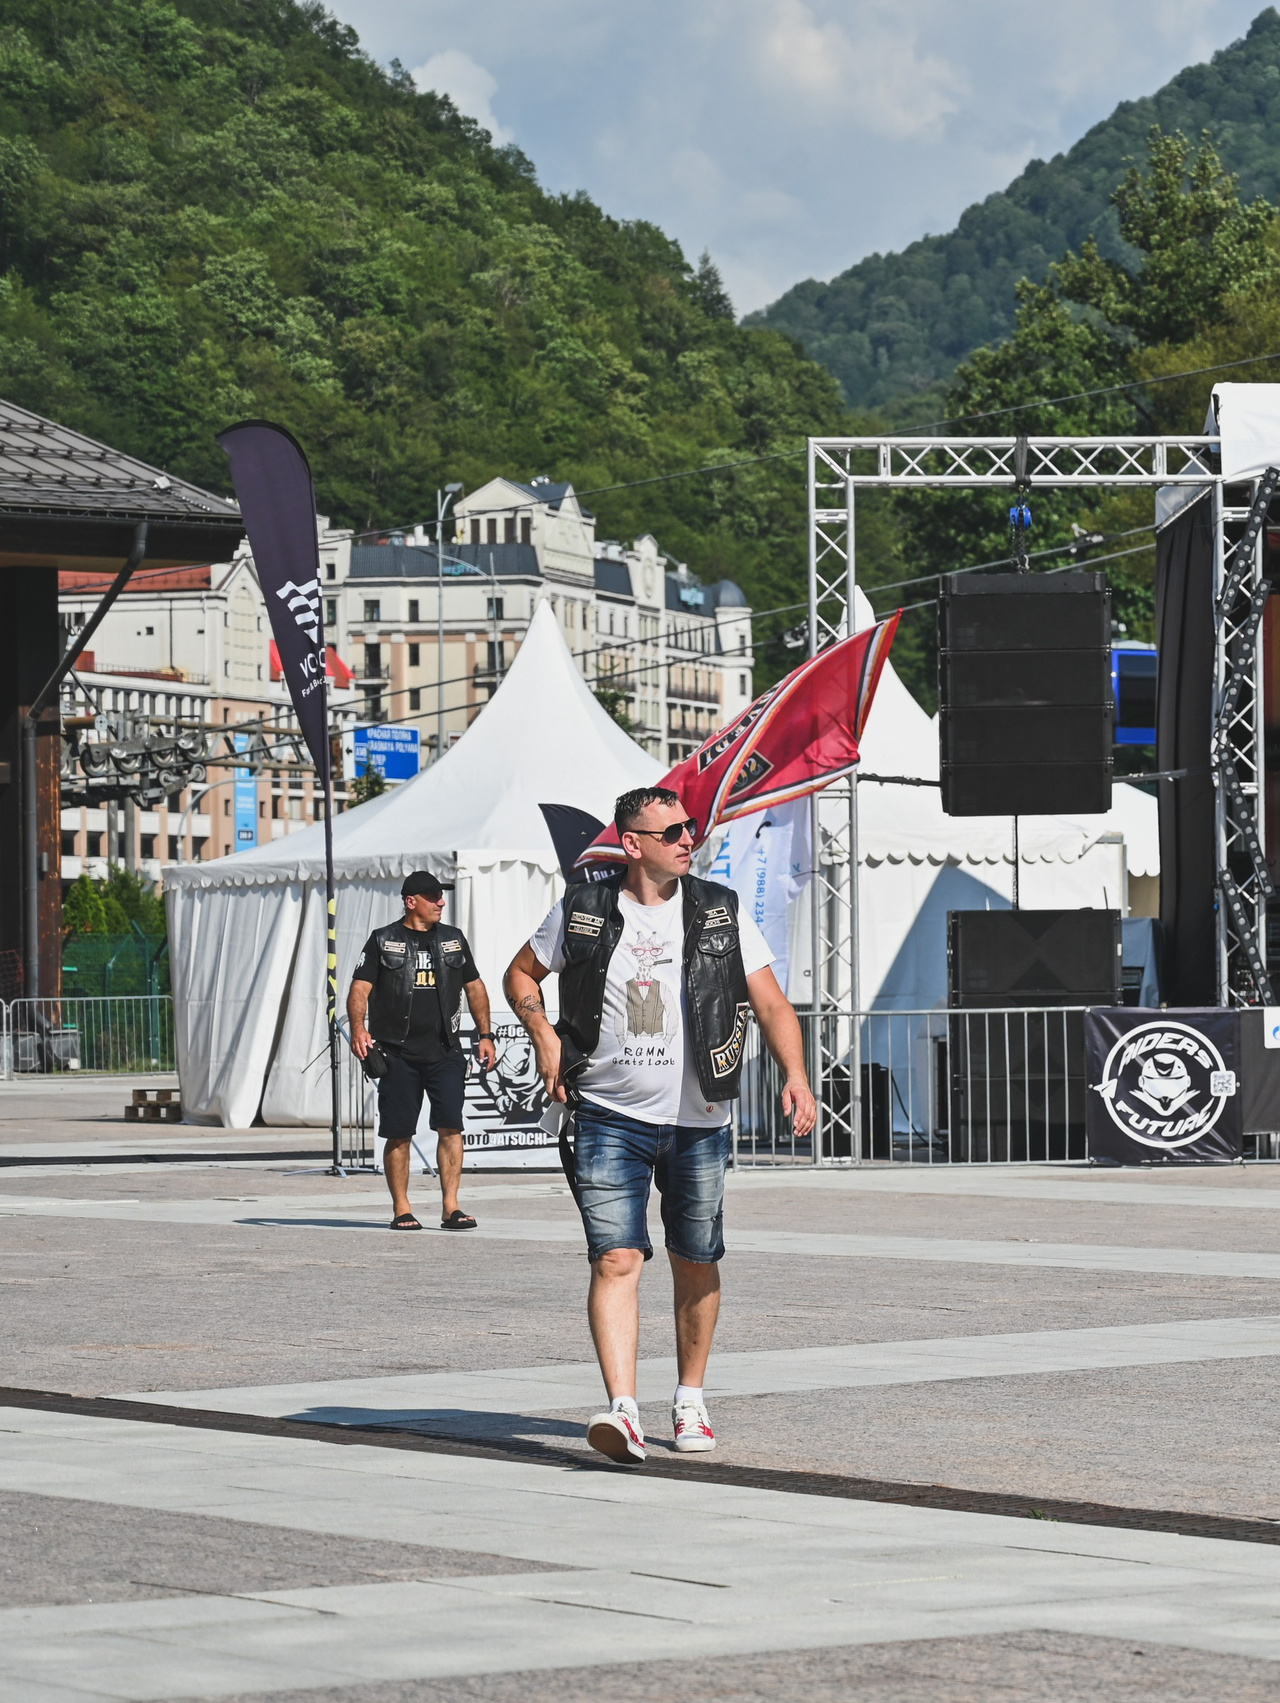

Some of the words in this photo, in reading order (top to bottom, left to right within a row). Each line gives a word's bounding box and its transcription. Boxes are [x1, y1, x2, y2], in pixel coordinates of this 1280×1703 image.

[755, 868, 767, 899] (988)
[623, 1047, 666, 1057] RGMN
[714, 1009, 748, 1073] RUSSIA
[1117, 1032, 1214, 1077] RIDERS
[1115, 1097, 1215, 1137] FUTURE
